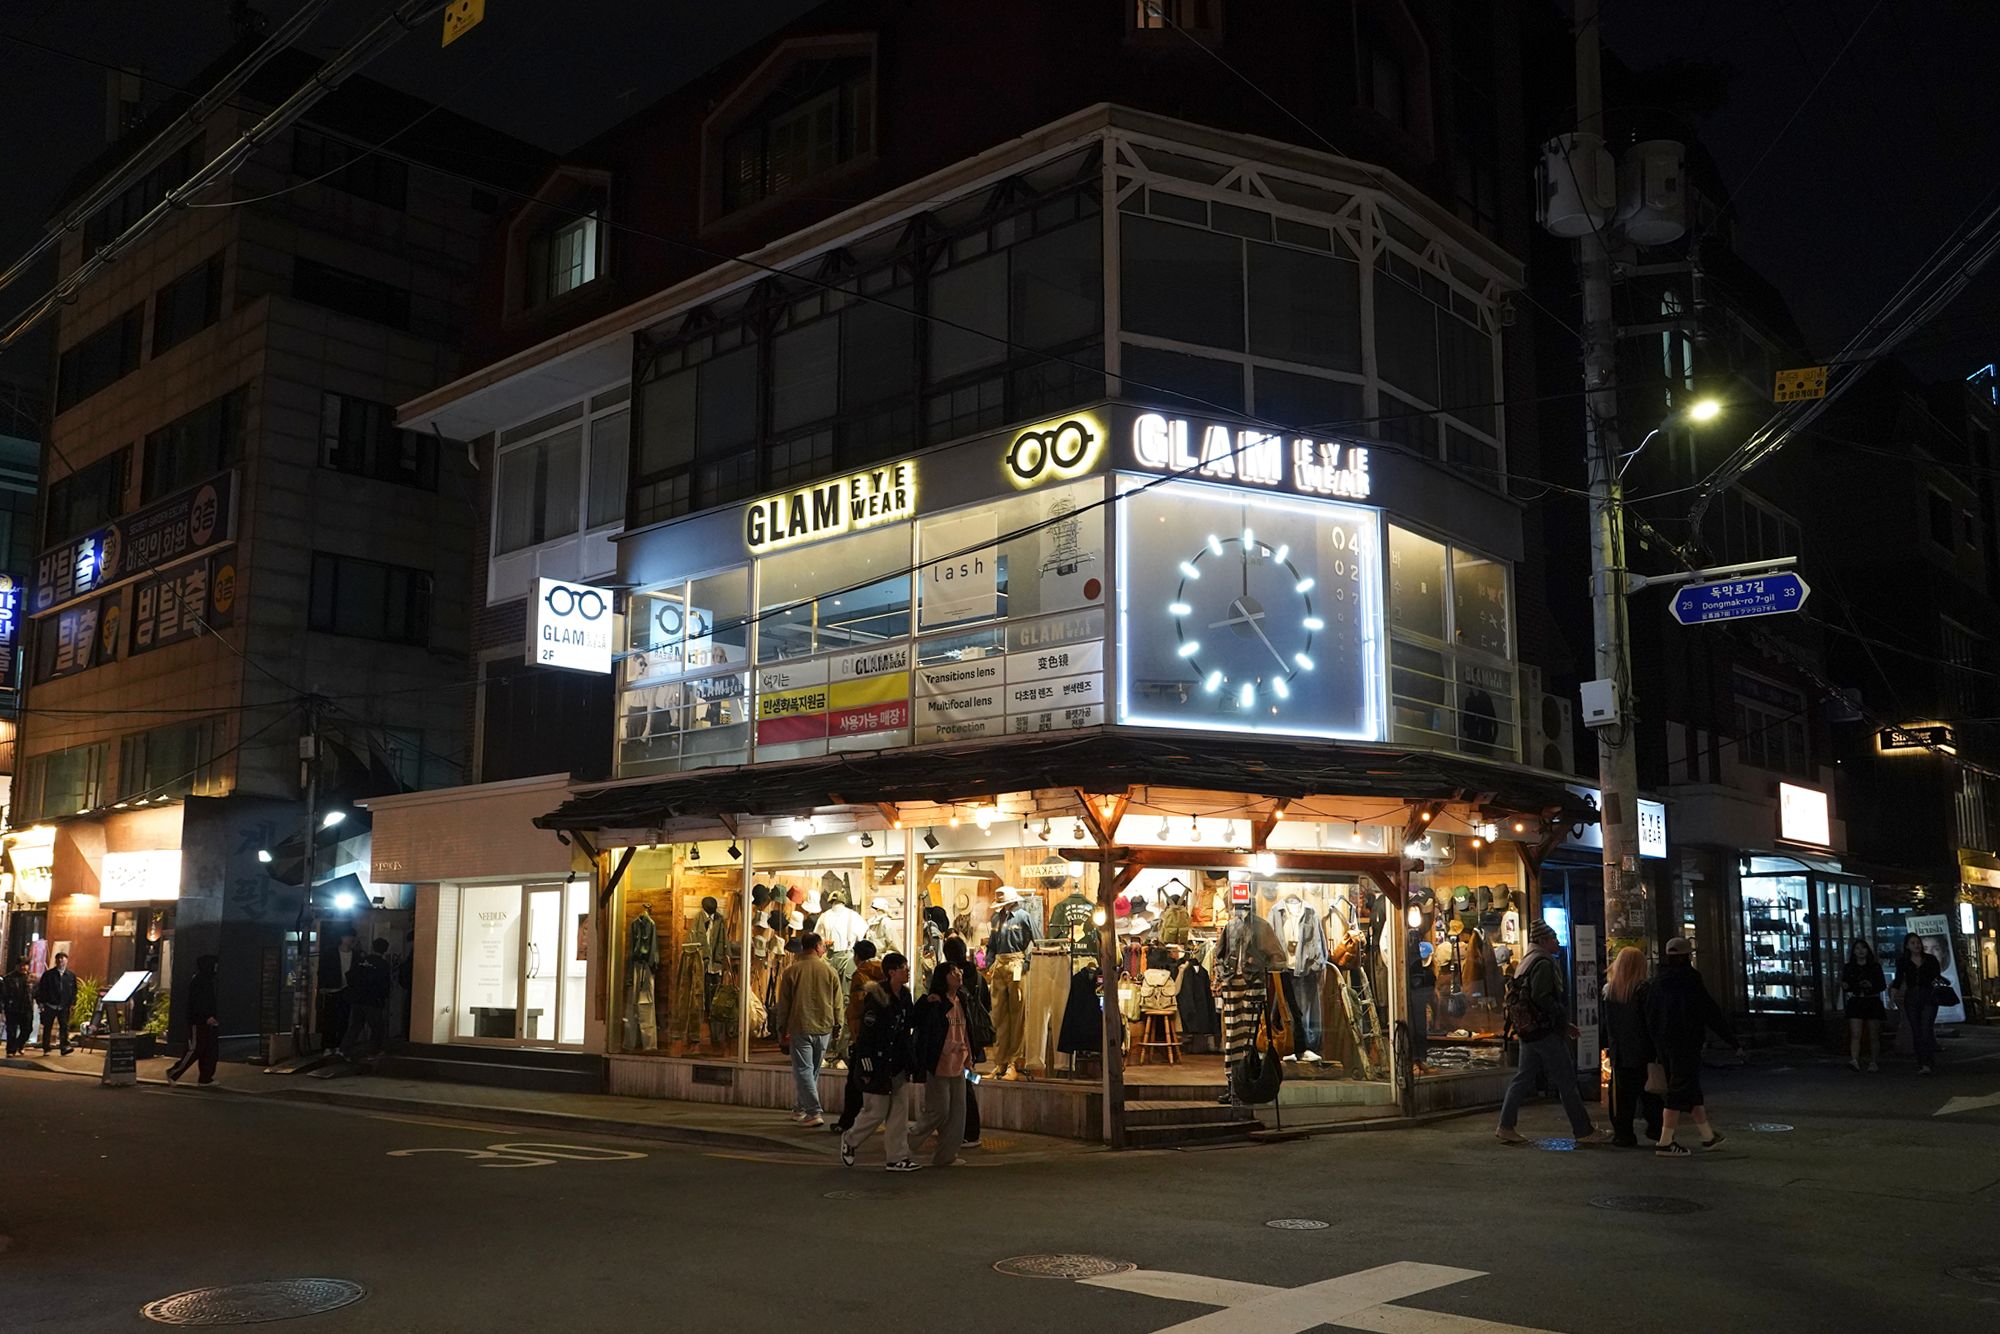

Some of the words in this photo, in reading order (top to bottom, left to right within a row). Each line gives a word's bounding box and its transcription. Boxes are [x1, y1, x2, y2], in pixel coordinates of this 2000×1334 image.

[1133, 414, 1282, 485] GLAM
[1294, 438, 1368, 472] EYE
[851, 466, 905, 499] EYE
[1294, 464, 1370, 498] WEAR
[193, 497, 215, 534] 3층
[747, 484, 839, 547] GLAM
[851, 489, 906, 521] WEAR
[38, 537, 97, 608] 방탈출
[934, 557, 984, 583] lash
[1710, 580, 1765, 598] 독막로7길
[1784, 587, 1796, 597] 33
[1702, 596, 1754, 610] Dongmak-ro
[1755, 594, 1776, 605] 7-gil
[543, 624, 585, 647] GLAM
[1020, 622, 1065, 647] GLAM
[543, 649, 555, 661] 2F
[1038, 653, 1069, 671] 变色镜
[926, 671, 975, 685] Transitions
[976, 666, 996, 679] lens
[927, 699, 973, 712] Multifocal
[974, 696, 993, 707] lens
[1015, 689, 1037, 701] 다초점
[1038, 687, 1053, 699] 렌즈
[839, 712, 880, 732] 사용가능
[936, 720, 986, 735] Protection
[1641, 812, 1662, 829] EYE
